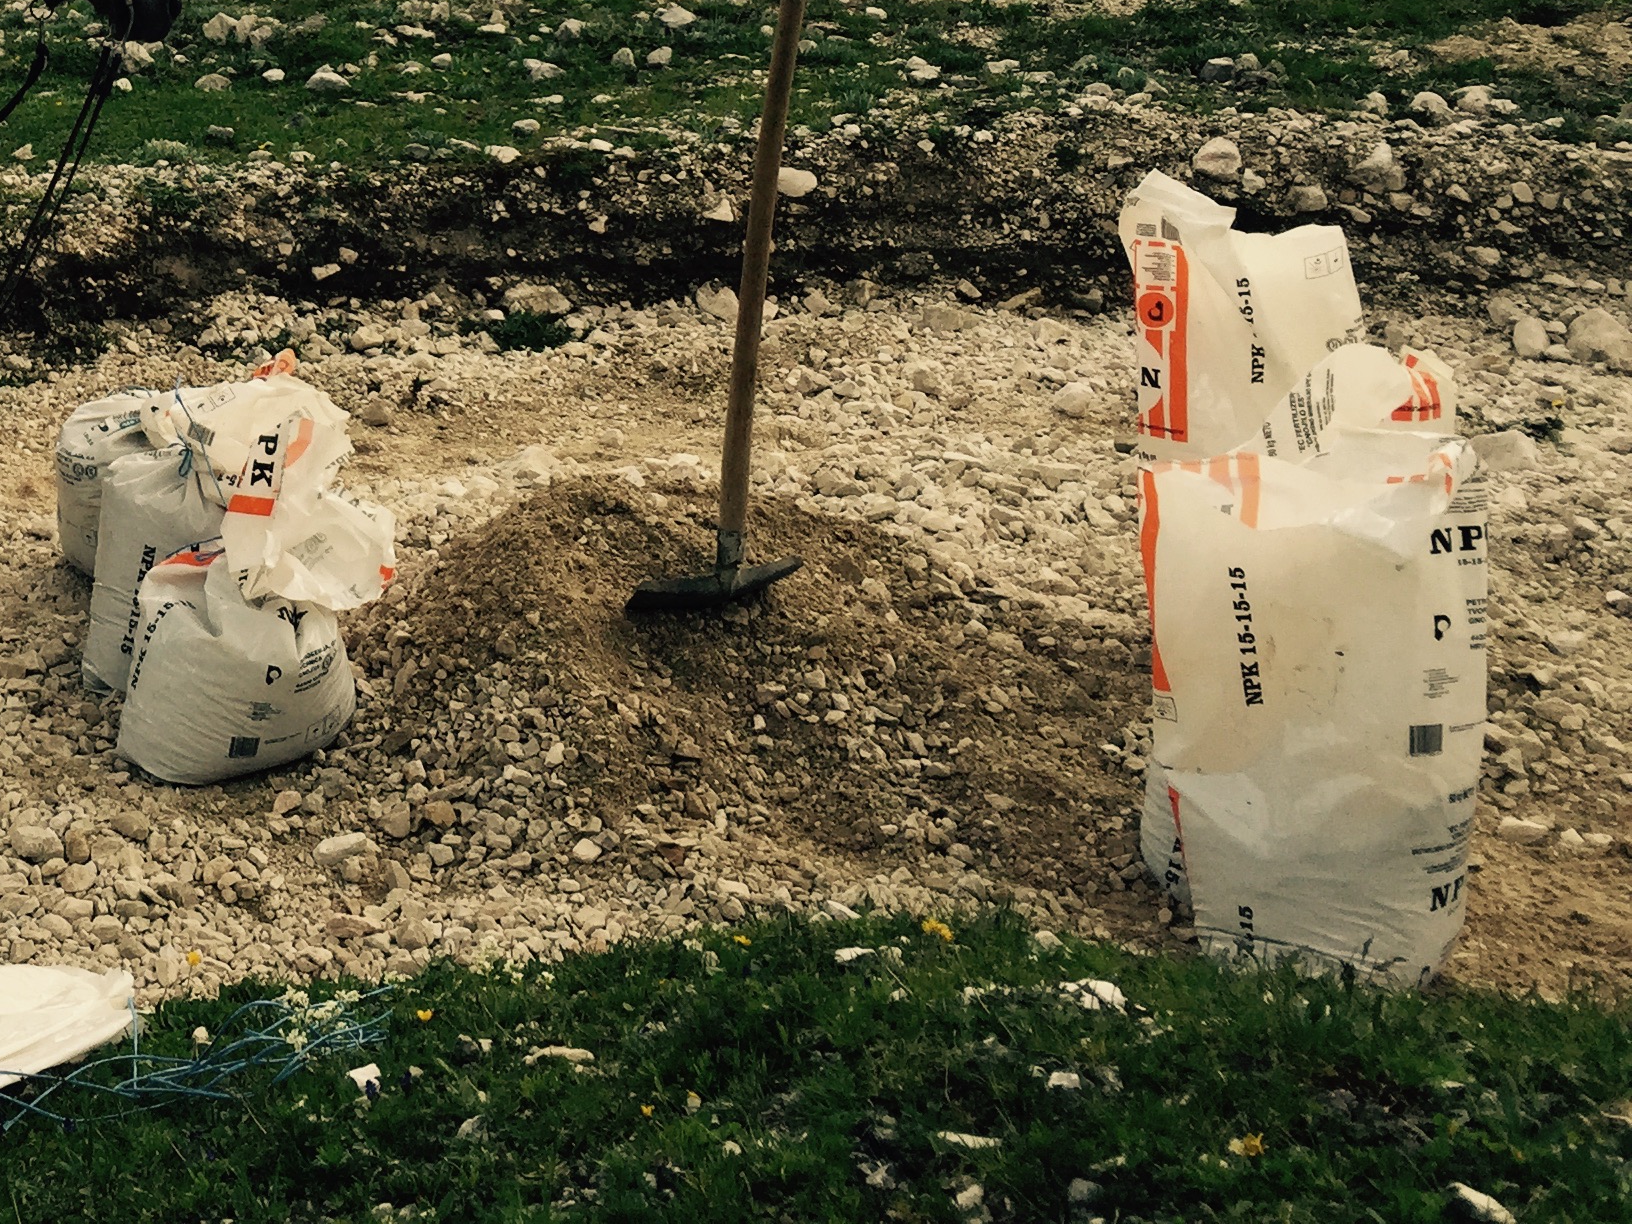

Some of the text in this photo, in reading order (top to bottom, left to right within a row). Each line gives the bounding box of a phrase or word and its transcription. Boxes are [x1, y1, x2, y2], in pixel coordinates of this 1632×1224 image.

[1251, 343, 1266, 384] NPK
[1429, 524, 1489, 555] NP
[1228, 565, 1264, 708] NPK 15-15-15
[1429, 874, 1466, 912] NP
